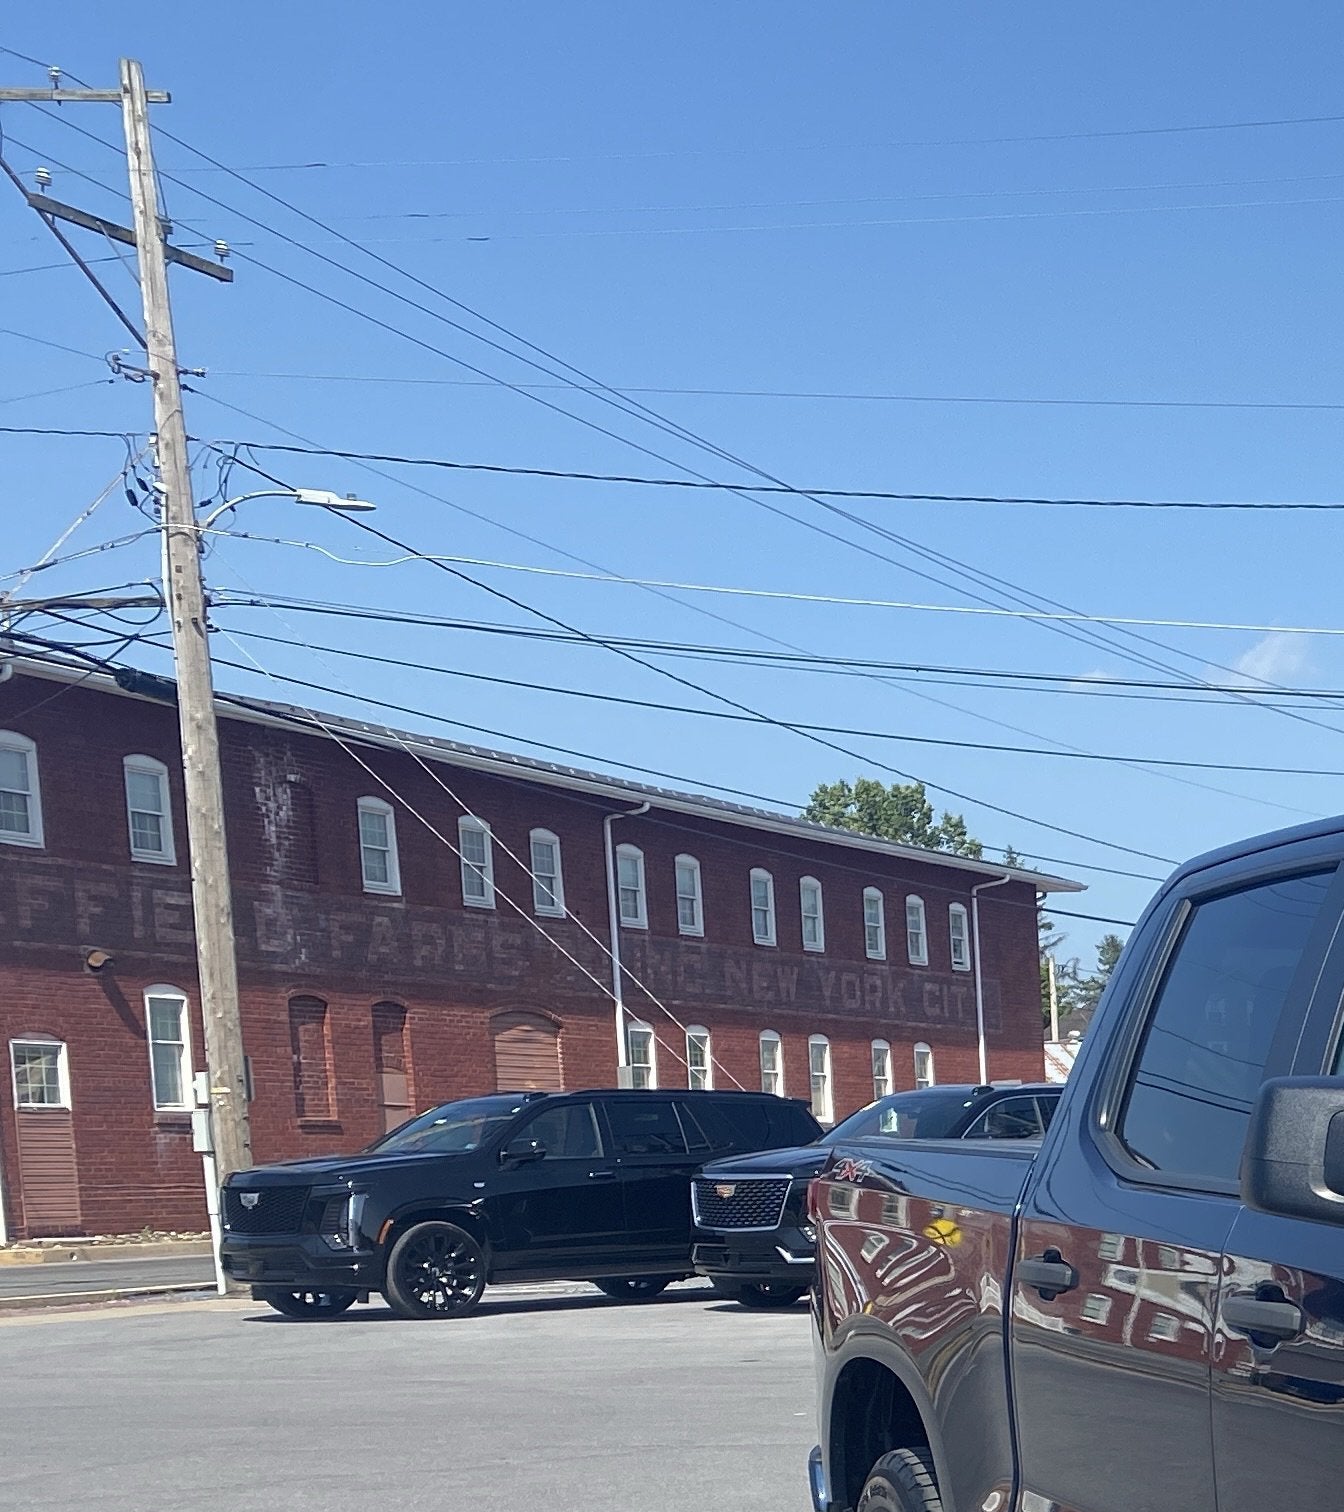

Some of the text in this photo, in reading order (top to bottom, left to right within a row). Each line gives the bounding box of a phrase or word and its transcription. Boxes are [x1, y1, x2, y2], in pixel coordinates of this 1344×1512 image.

[724, 958, 798, 1002] NEW
[817, 968, 906, 1015] YORK
[922, 980, 973, 1019] CIT
